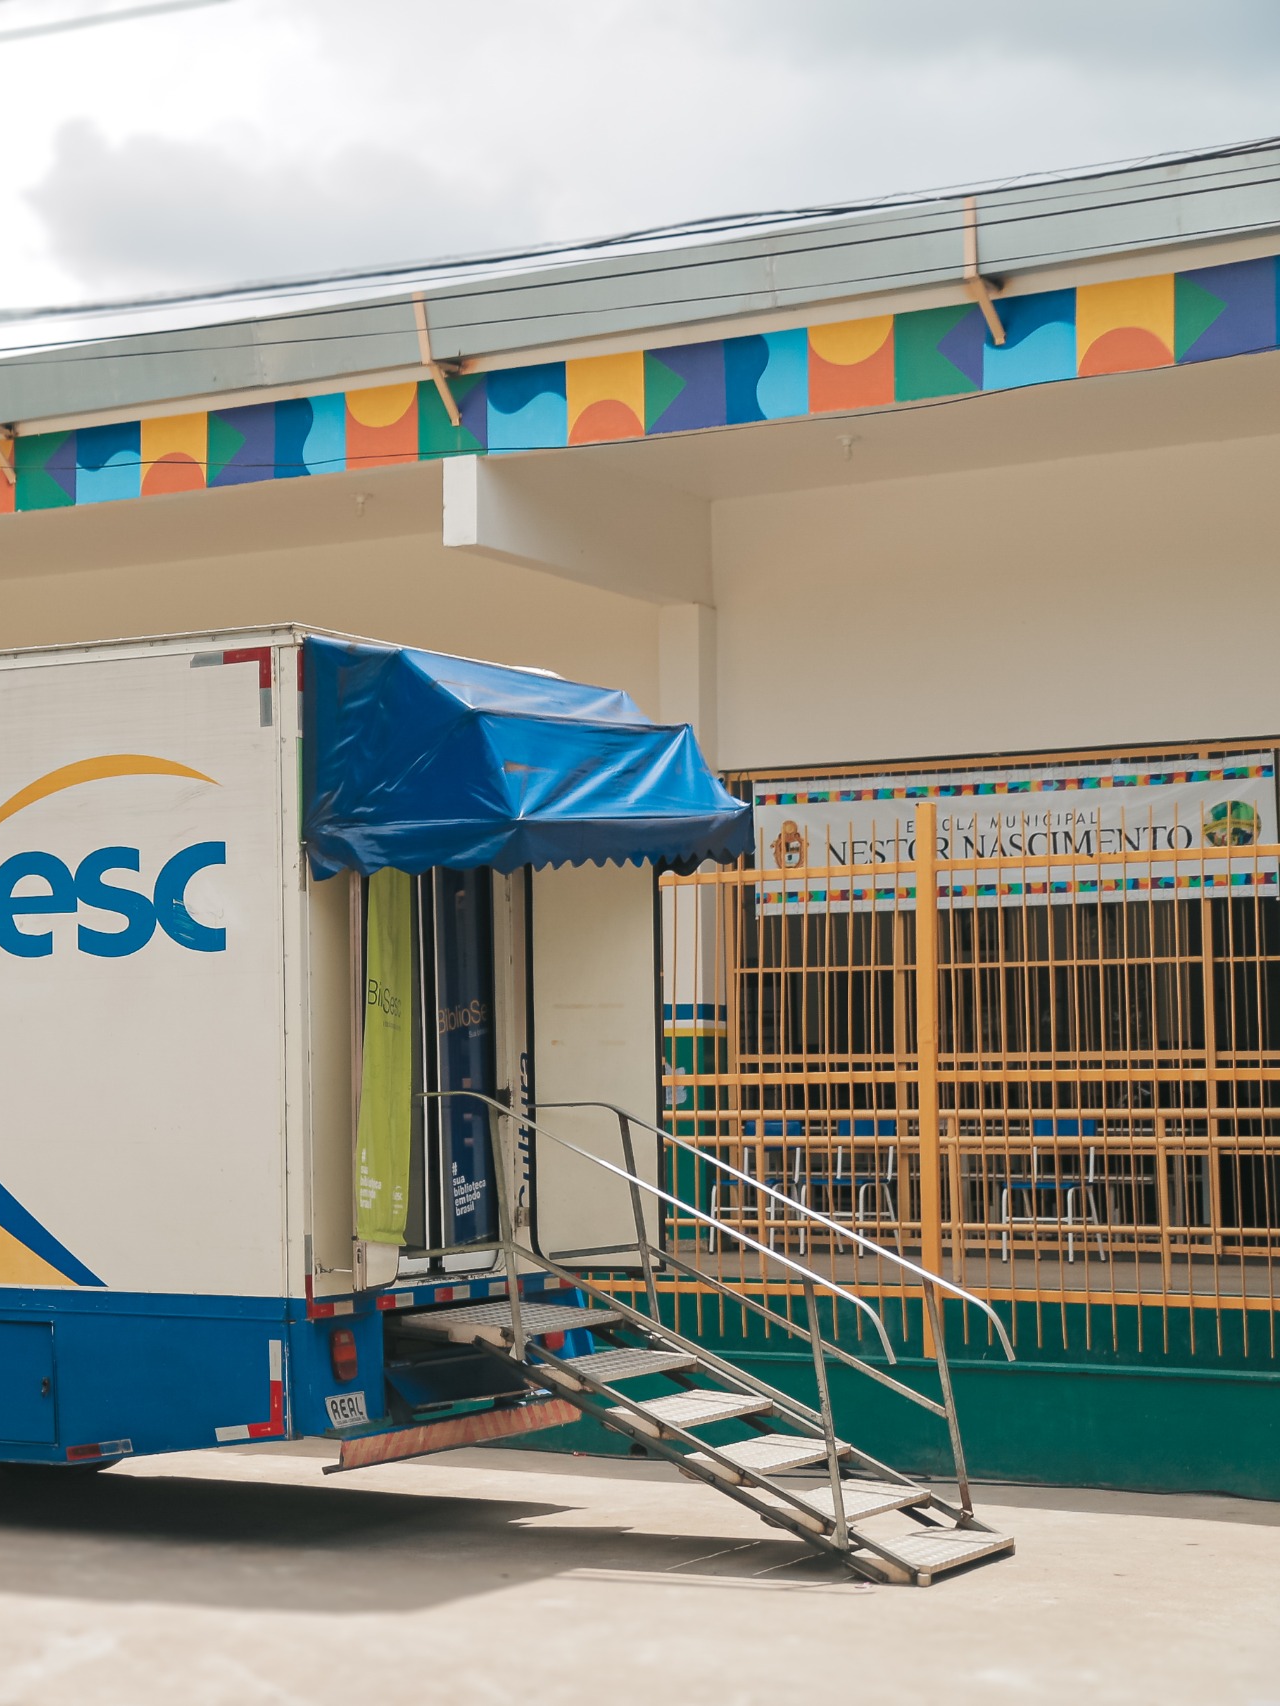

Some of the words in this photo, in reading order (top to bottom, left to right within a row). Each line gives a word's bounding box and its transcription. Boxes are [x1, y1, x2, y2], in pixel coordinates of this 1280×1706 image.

[906, 817, 977, 833] ECOLA
[990, 812, 1097, 829] MUNICIPAL
[963, 825, 1193, 859] NASCIMENTO
[452, 1161, 458, 1176] #
[453, 1176, 465, 1185] sua
[454, 1180, 486, 1197] biblioteca
[455, 1196, 466, 1207] em
[465, 1190, 481, 1203] todo
[456, 1202, 474, 1216] brasil
[331, 1397, 363, 1420] REAL
